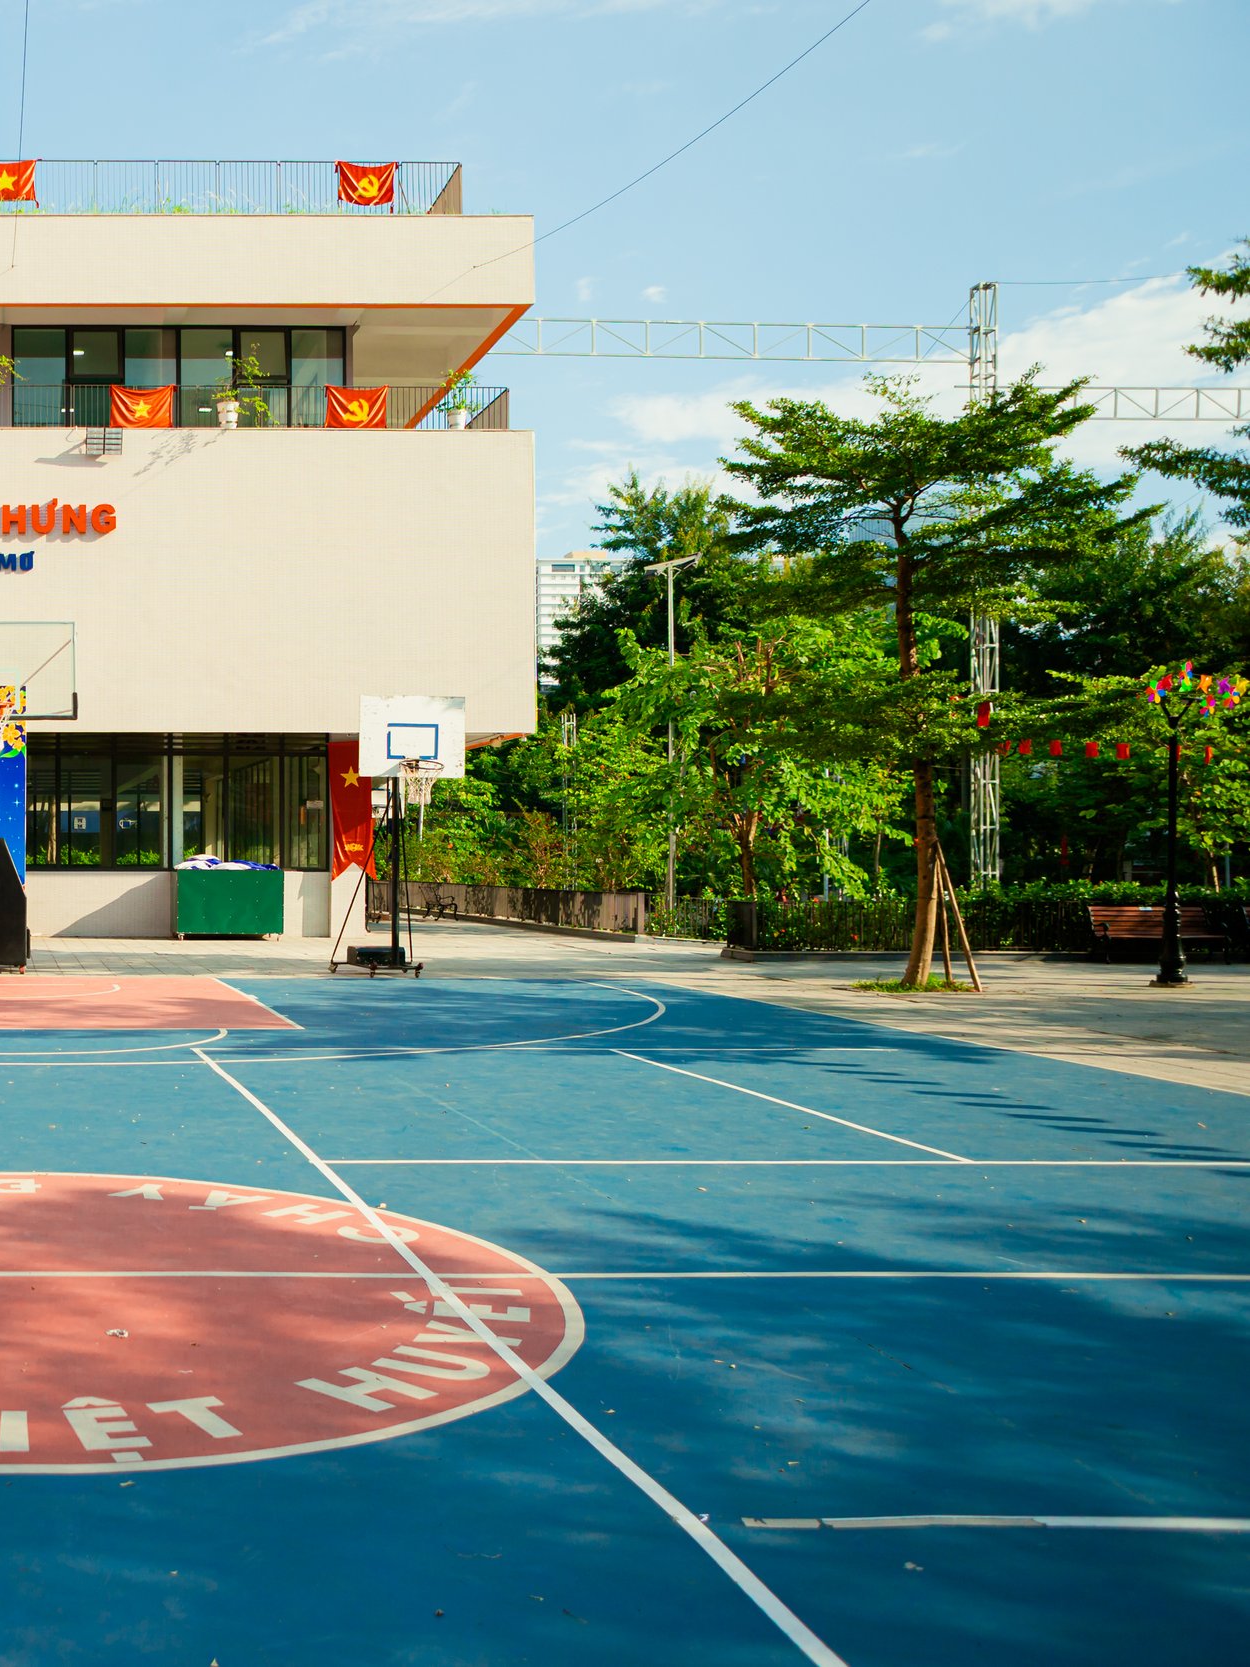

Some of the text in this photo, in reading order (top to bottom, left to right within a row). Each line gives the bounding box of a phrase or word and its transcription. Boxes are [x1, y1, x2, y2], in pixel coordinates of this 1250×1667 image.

[2, 498, 116, 534] HƯNG
[108, 1183, 420, 1243] CHÁY
[293, 1281, 531, 1412] HUYẾT
